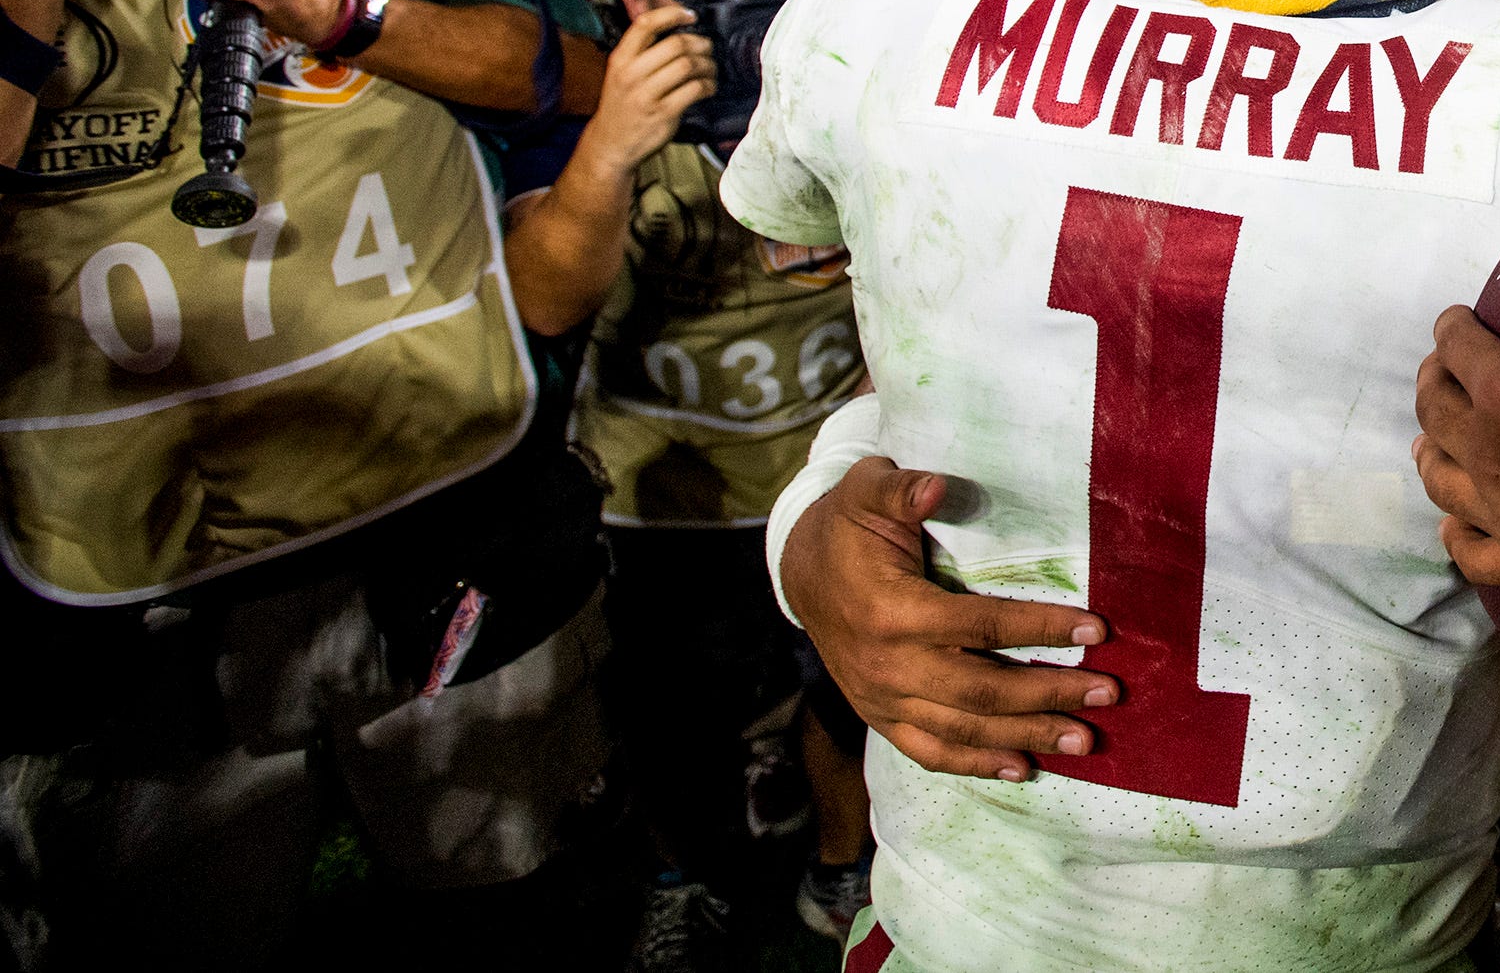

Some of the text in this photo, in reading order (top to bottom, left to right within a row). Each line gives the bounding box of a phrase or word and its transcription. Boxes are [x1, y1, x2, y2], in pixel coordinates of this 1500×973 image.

[78, 172, 416, 374] 074
[644, 322, 852, 417] 036
[1032, 186, 1250, 808] 1
